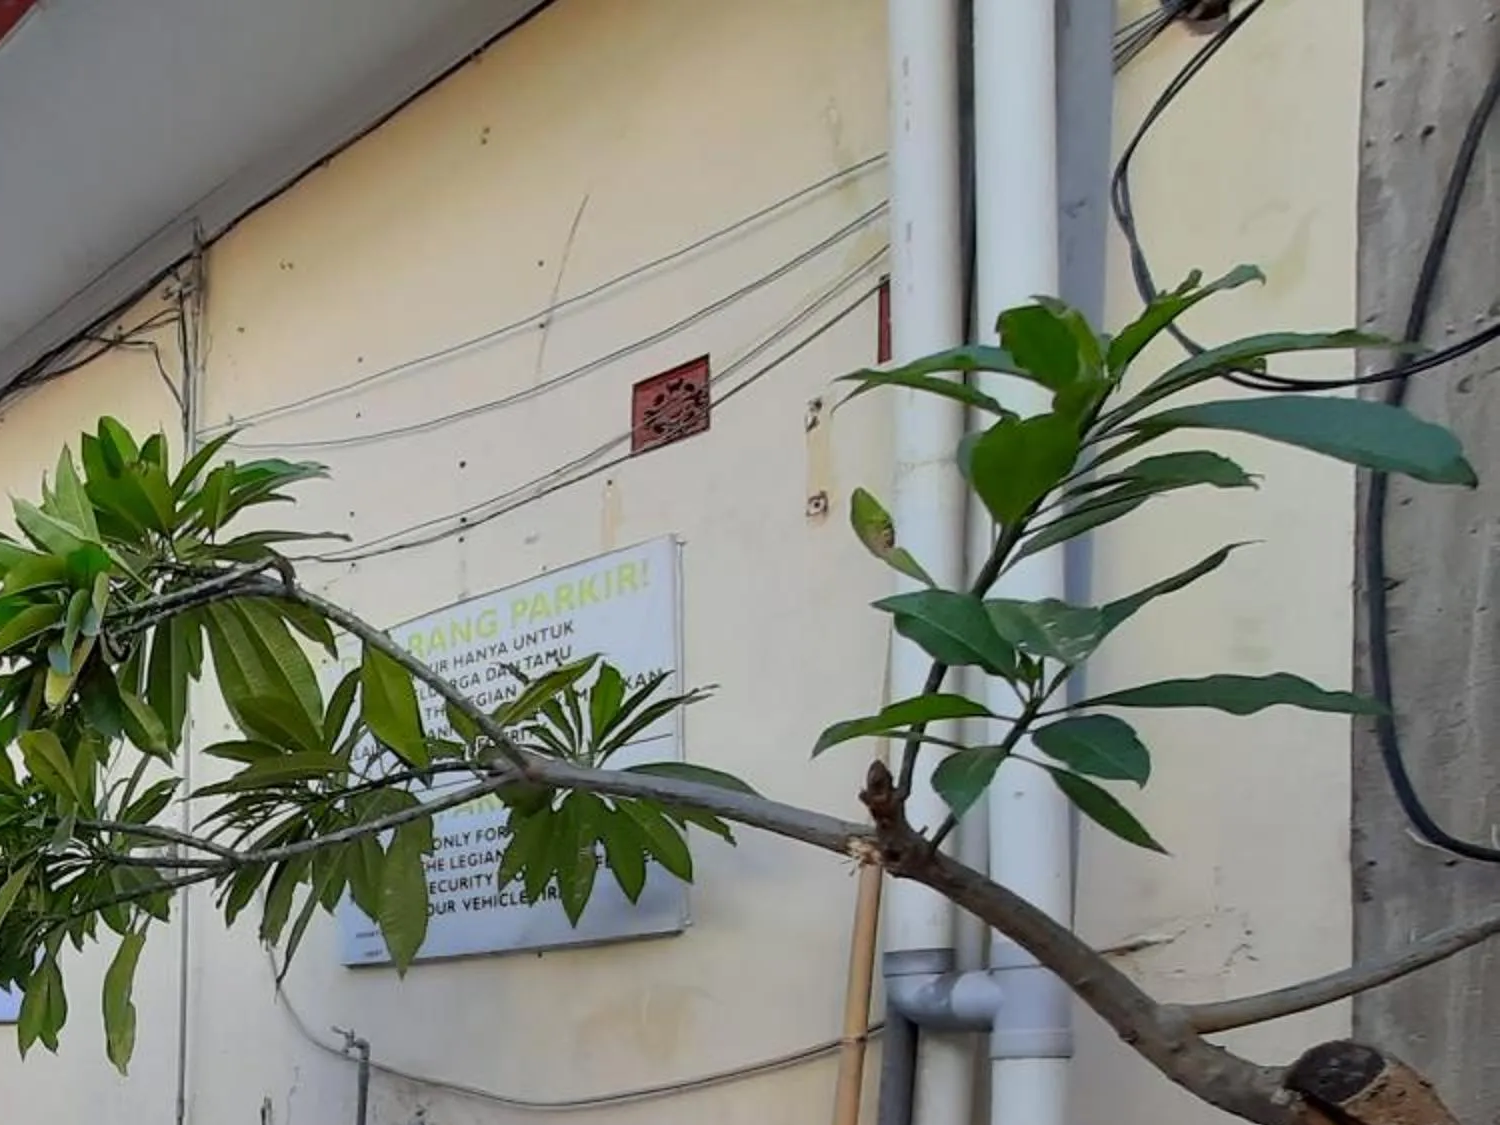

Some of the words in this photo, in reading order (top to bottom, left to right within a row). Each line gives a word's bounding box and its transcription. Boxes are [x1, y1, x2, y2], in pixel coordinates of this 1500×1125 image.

[510, 558, 650, 628] PARKIR!
[452, 642, 508, 668] HANYA
[512, 620, 575, 652] UNTUK
[524, 646, 573, 672] TAMU
[432, 832, 470, 850] ONLY
[426, 857, 445, 873] HE
[429, 876, 493, 894] ECURITY
[462, 890, 530, 912] VEHICLE
